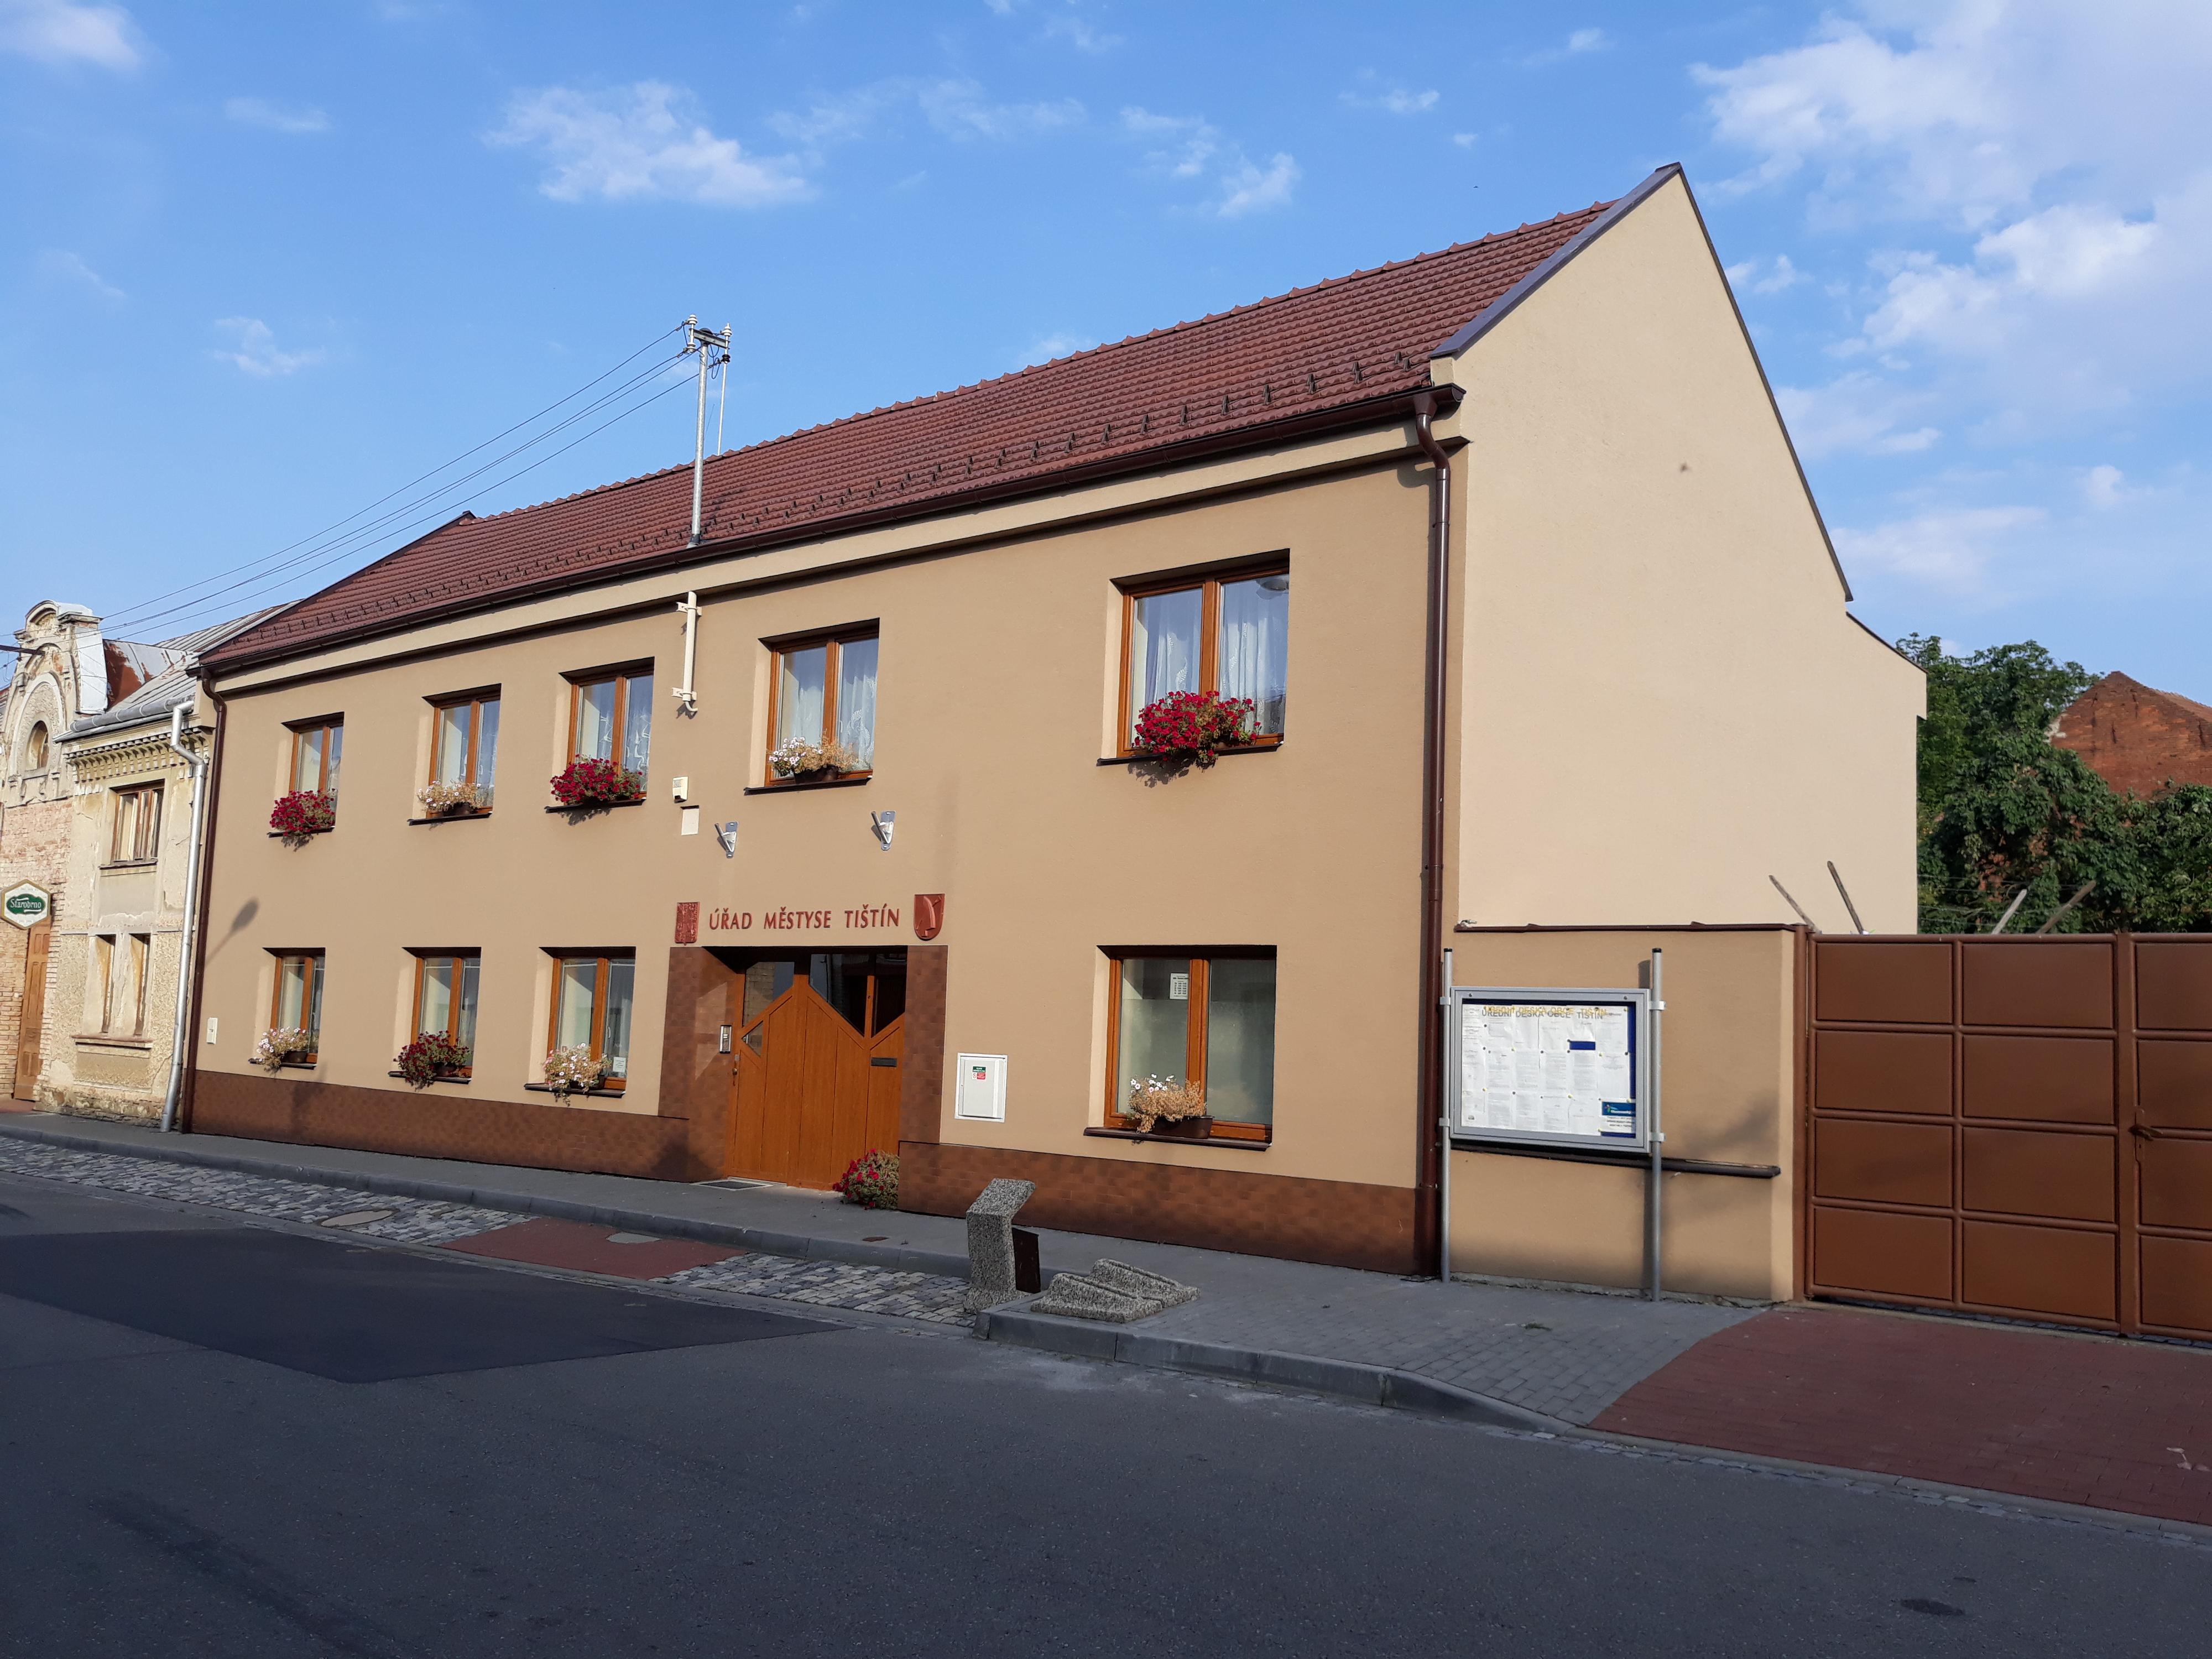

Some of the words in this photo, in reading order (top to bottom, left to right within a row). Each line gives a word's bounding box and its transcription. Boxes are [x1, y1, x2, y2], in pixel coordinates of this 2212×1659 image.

[10, 899, 41, 909] Starobrno
[709, 907, 753, 930] ÚŘAD
[764, 906, 832, 930] MĚSTYSE
[844, 903, 900, 928] TIŠTÍN
[1516, 1006, 1547, 1017] DESKA
[1547, 1007, 1575, 1018] OBCE
